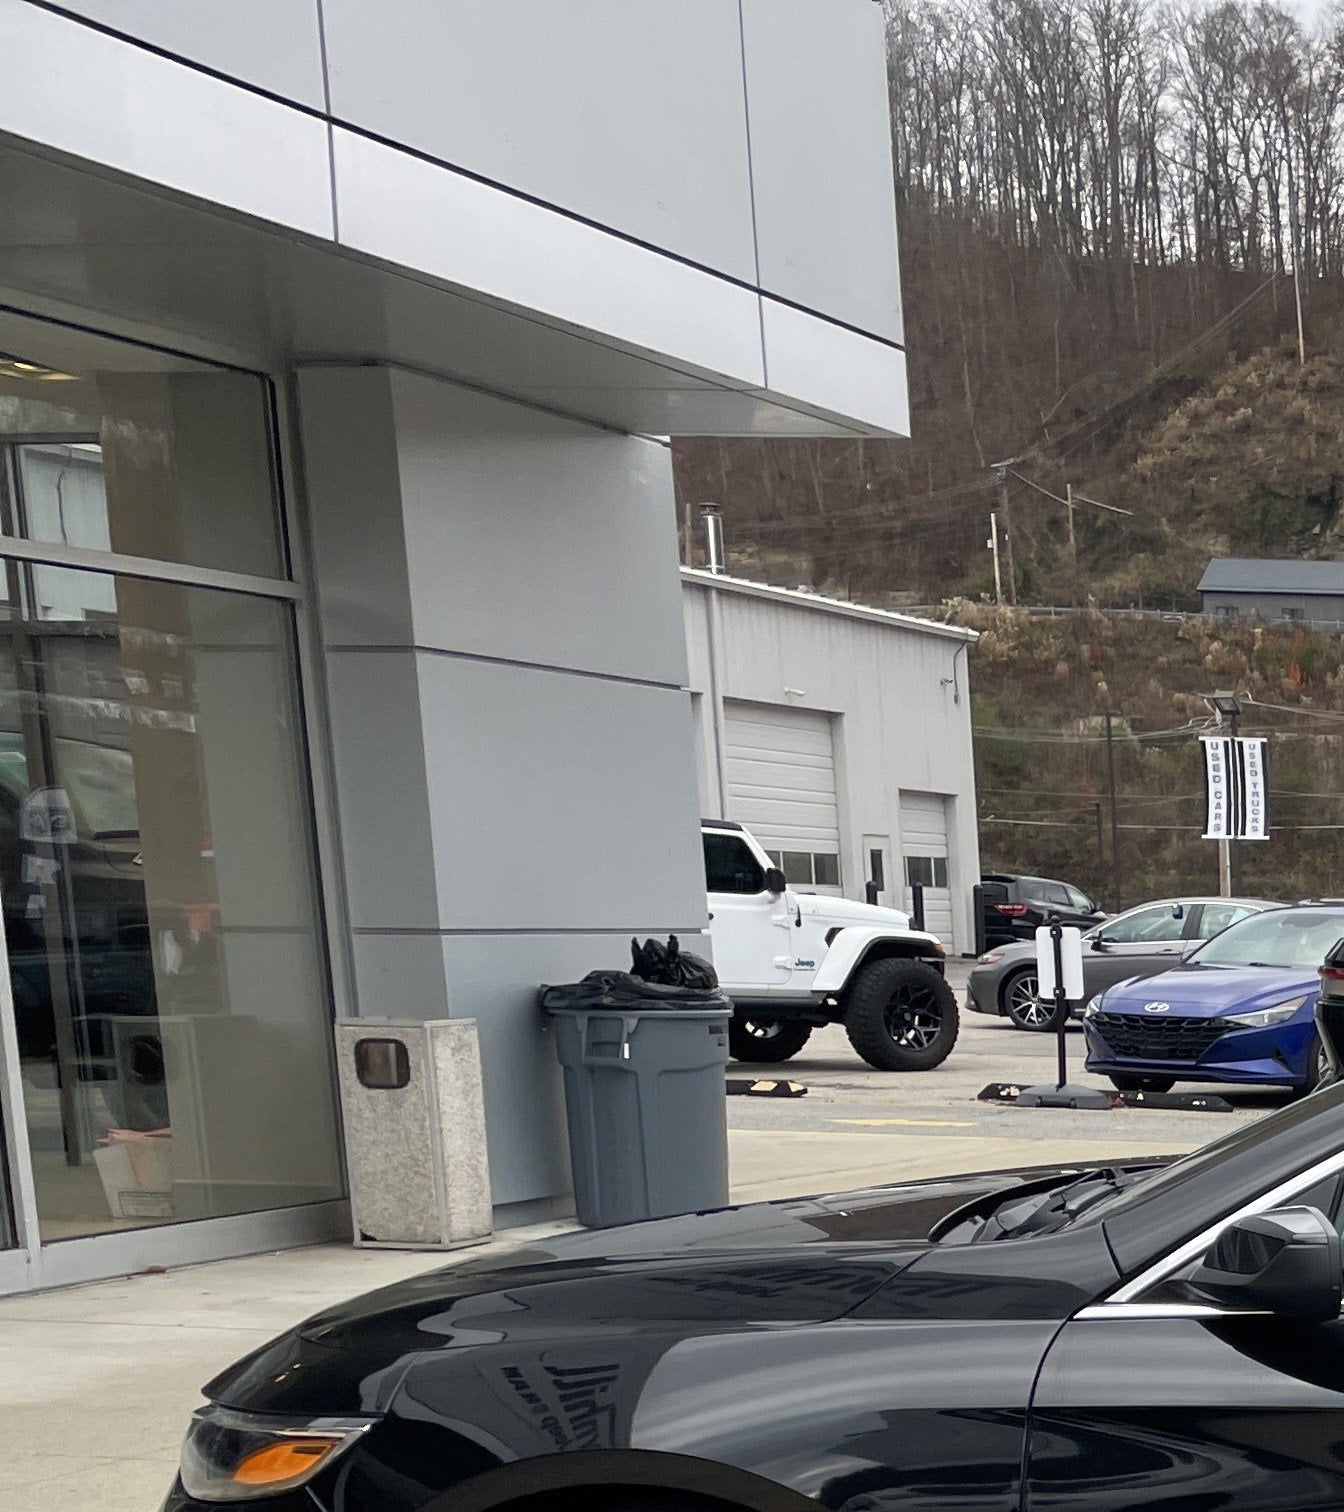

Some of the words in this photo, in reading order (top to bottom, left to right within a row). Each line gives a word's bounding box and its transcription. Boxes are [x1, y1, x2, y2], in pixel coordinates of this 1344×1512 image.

[1210, 741, 1222, 784] USED
[1248, 743, 1258, 777] USED
[1213, 790, 1223, 832] CARS
[1251, 782, 1260, 832] TRUCKS
[795, 958, 815, 967] Jeep
